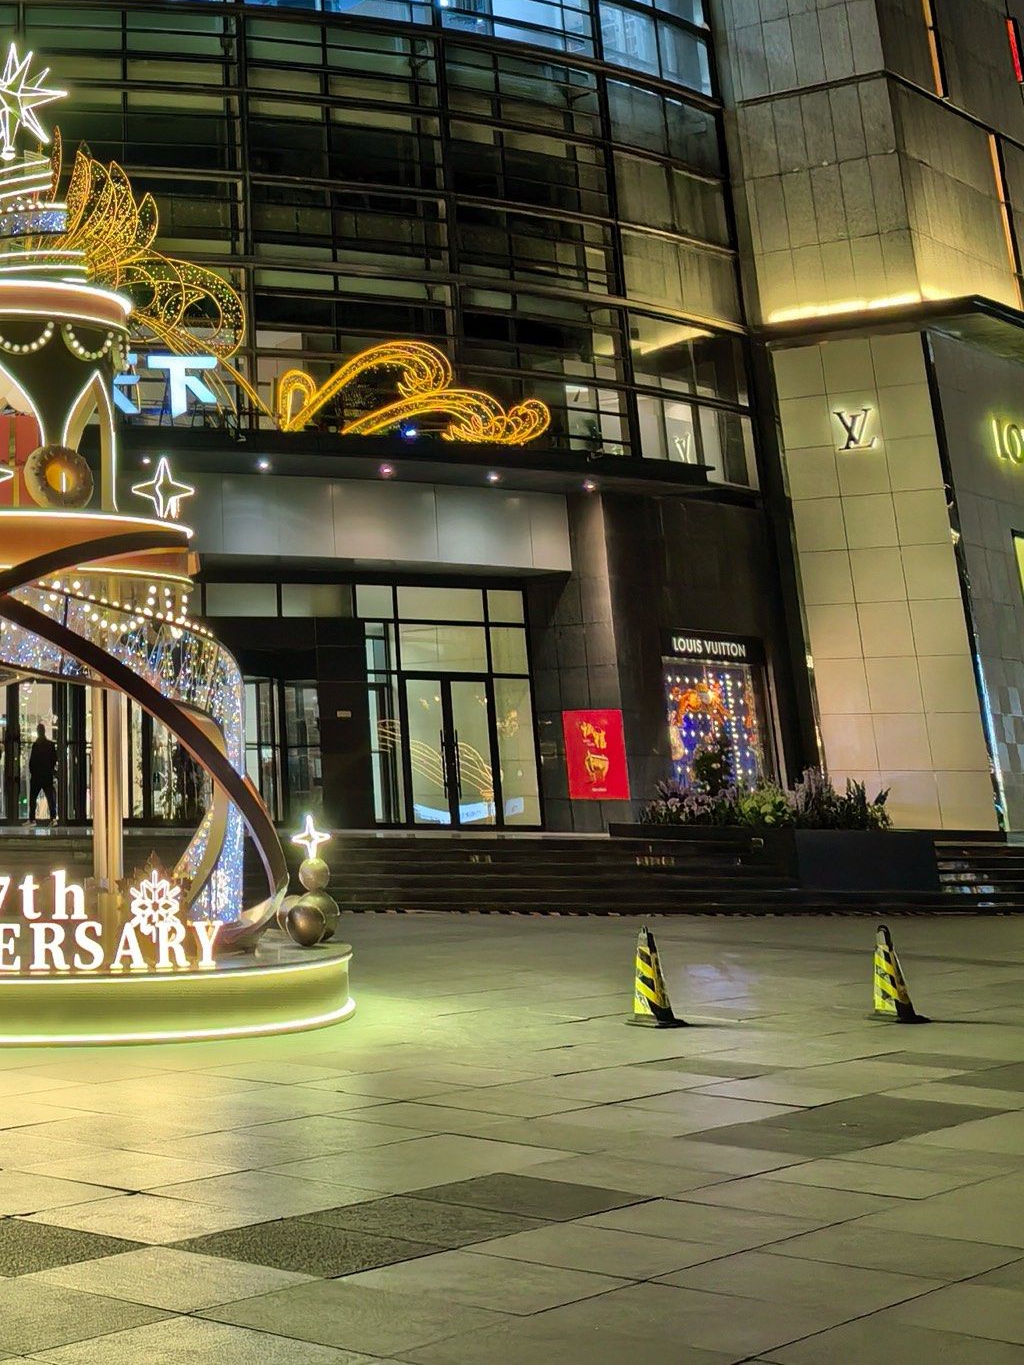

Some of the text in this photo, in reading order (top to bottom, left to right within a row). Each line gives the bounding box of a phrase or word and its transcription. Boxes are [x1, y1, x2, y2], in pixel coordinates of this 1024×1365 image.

[833, 407, 878, 451] LV
[672, 637, 747, 658] LOUIS VUITTON
